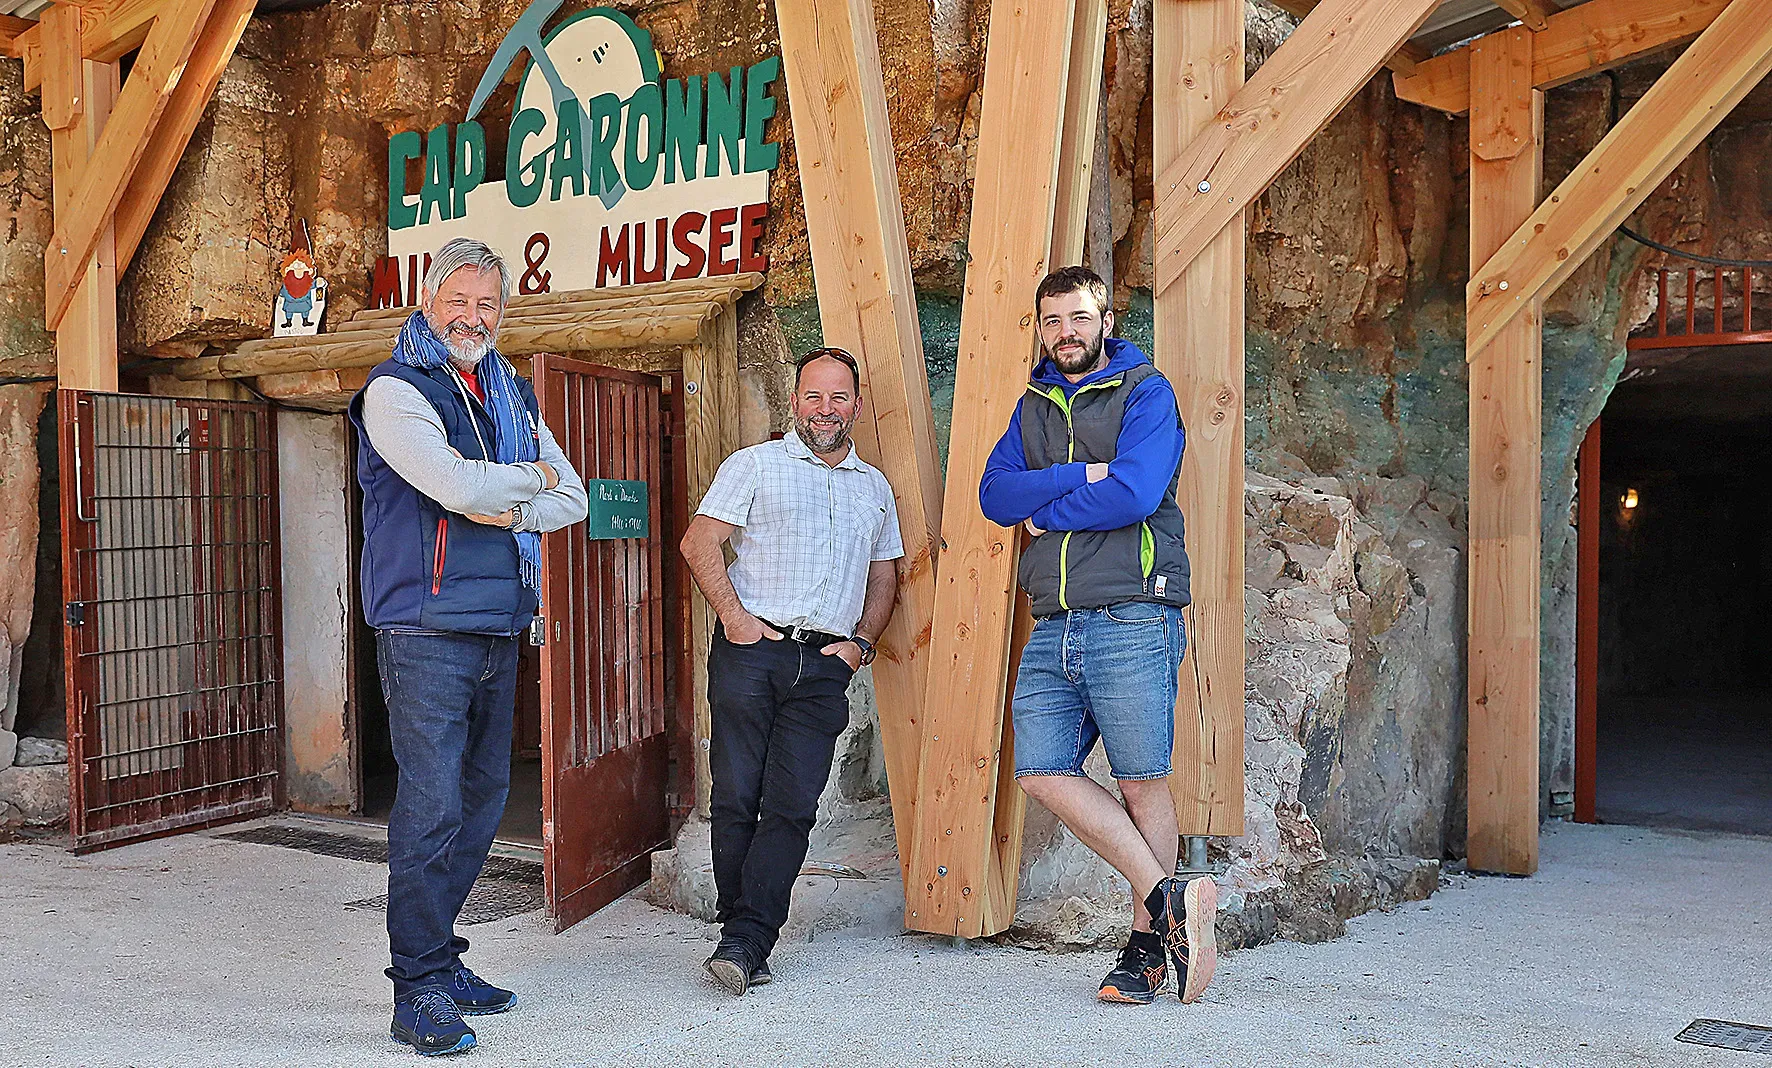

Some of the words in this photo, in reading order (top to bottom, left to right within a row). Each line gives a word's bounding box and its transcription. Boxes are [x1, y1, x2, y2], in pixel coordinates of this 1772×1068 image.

[388, 120, 486, 230] CAP
[506, 55, 780, 207] GARONNE
[519, 232, 551, 296] &
[595, 202, 769, 289] MUSEE
